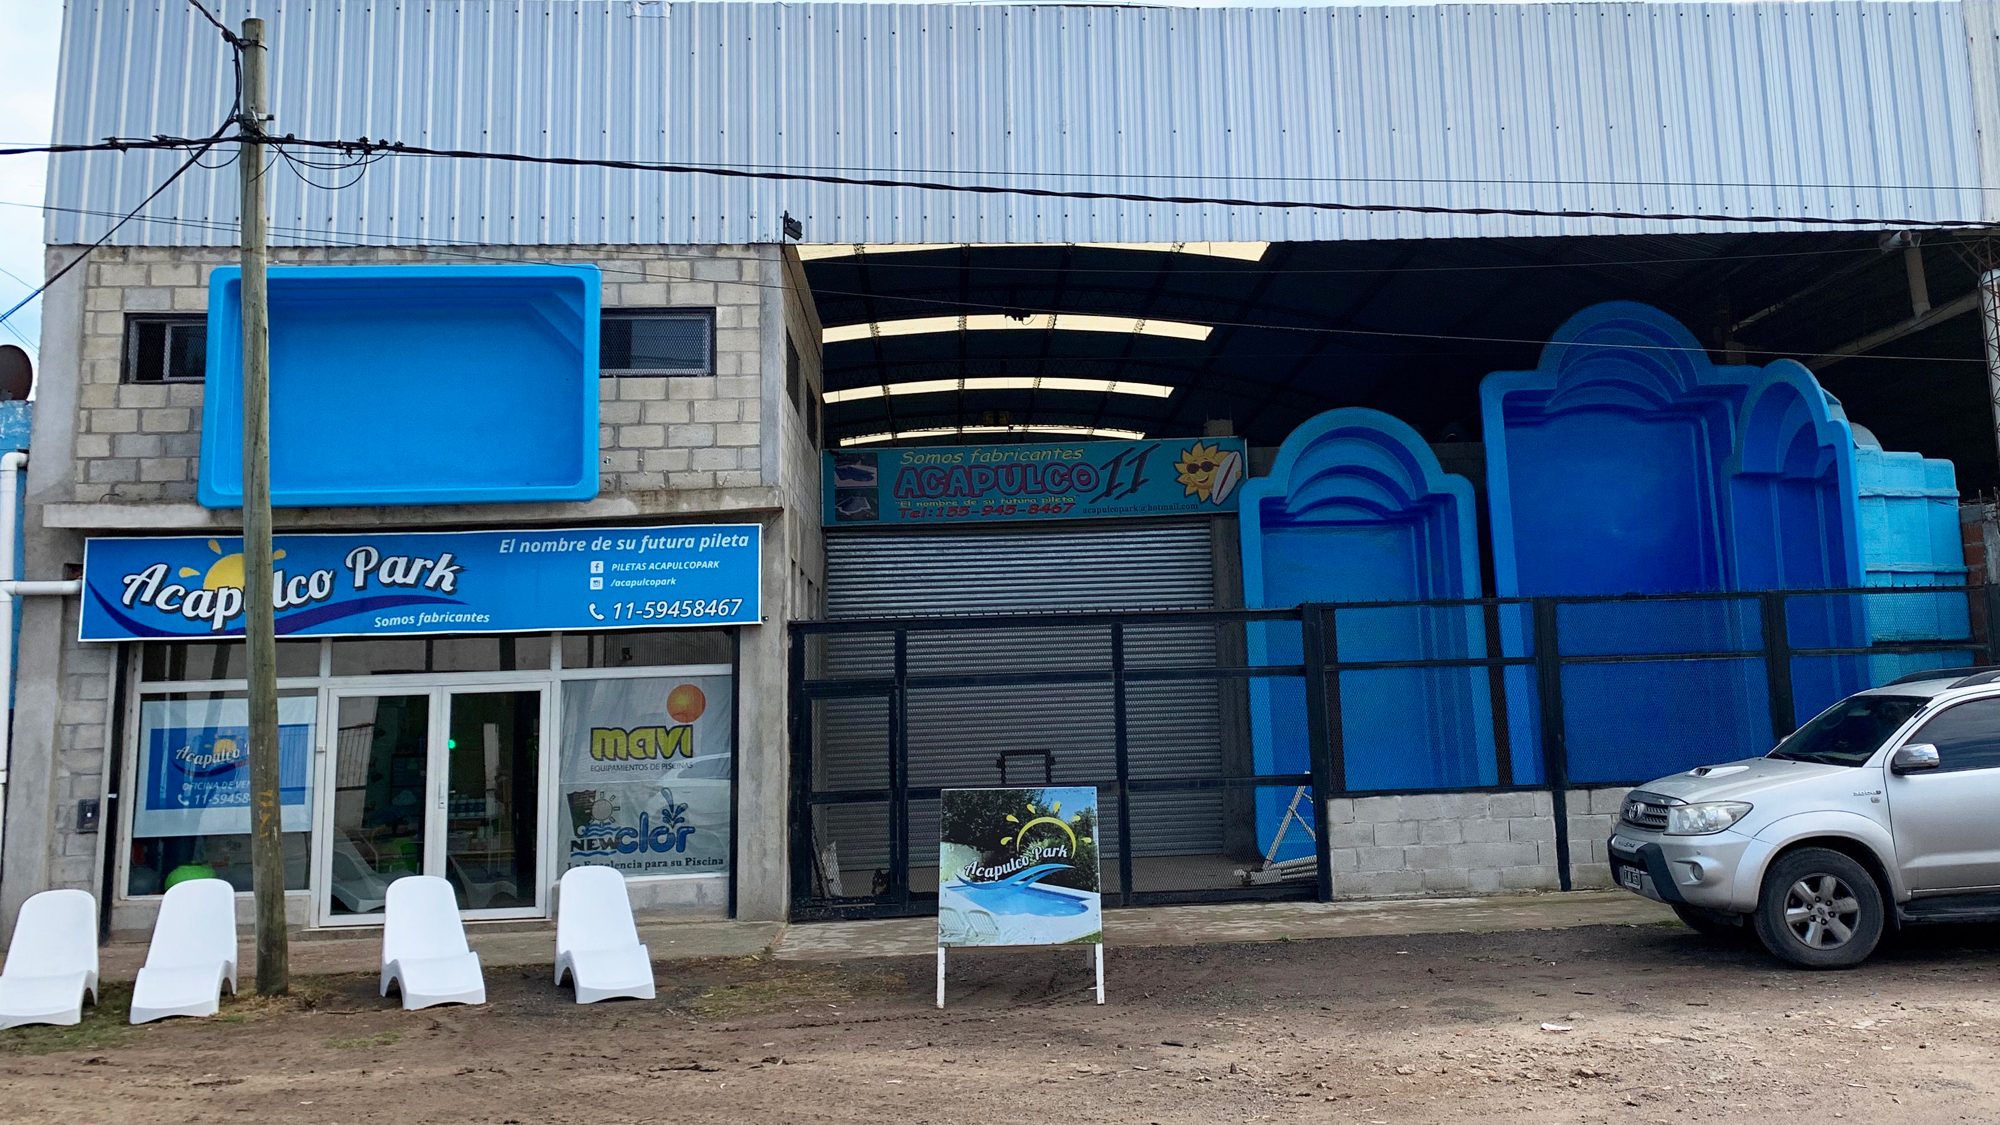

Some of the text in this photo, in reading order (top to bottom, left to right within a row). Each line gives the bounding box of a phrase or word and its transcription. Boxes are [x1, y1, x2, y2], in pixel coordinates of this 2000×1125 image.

[900, 447, 1084, 465] Somos fabricantes
[893, 461, 1100, 499] ACAPULCO
[916, 499, 958, 507] nombre
[963, 498, 977, 506] de
[499, 533, 749, 554] El nombre de su futura pileta
[611, 562, 647, 572] PILETAS
[649, 560, 721, 571] ACAPULCOPARK
[121, 545, 462, 631] Acaplco Park
[610, 577, 677, 588] /acapulcopark
[612, 598, 743, 620] 11-59458467
[374, 611, 491, 628] Somos fabricantes
[590, 724, 694, 761] mavi
[176, 745, 240, 769] Acapulco
[590, 762, 649, 773] EQUIPAMIENTOS
[650, 762, 661, 771] DE
[645, 859, 668, 871] para
[685, 857, 724, 867] Piscina
[965, 845, 1068, 880] Acapulco Park
